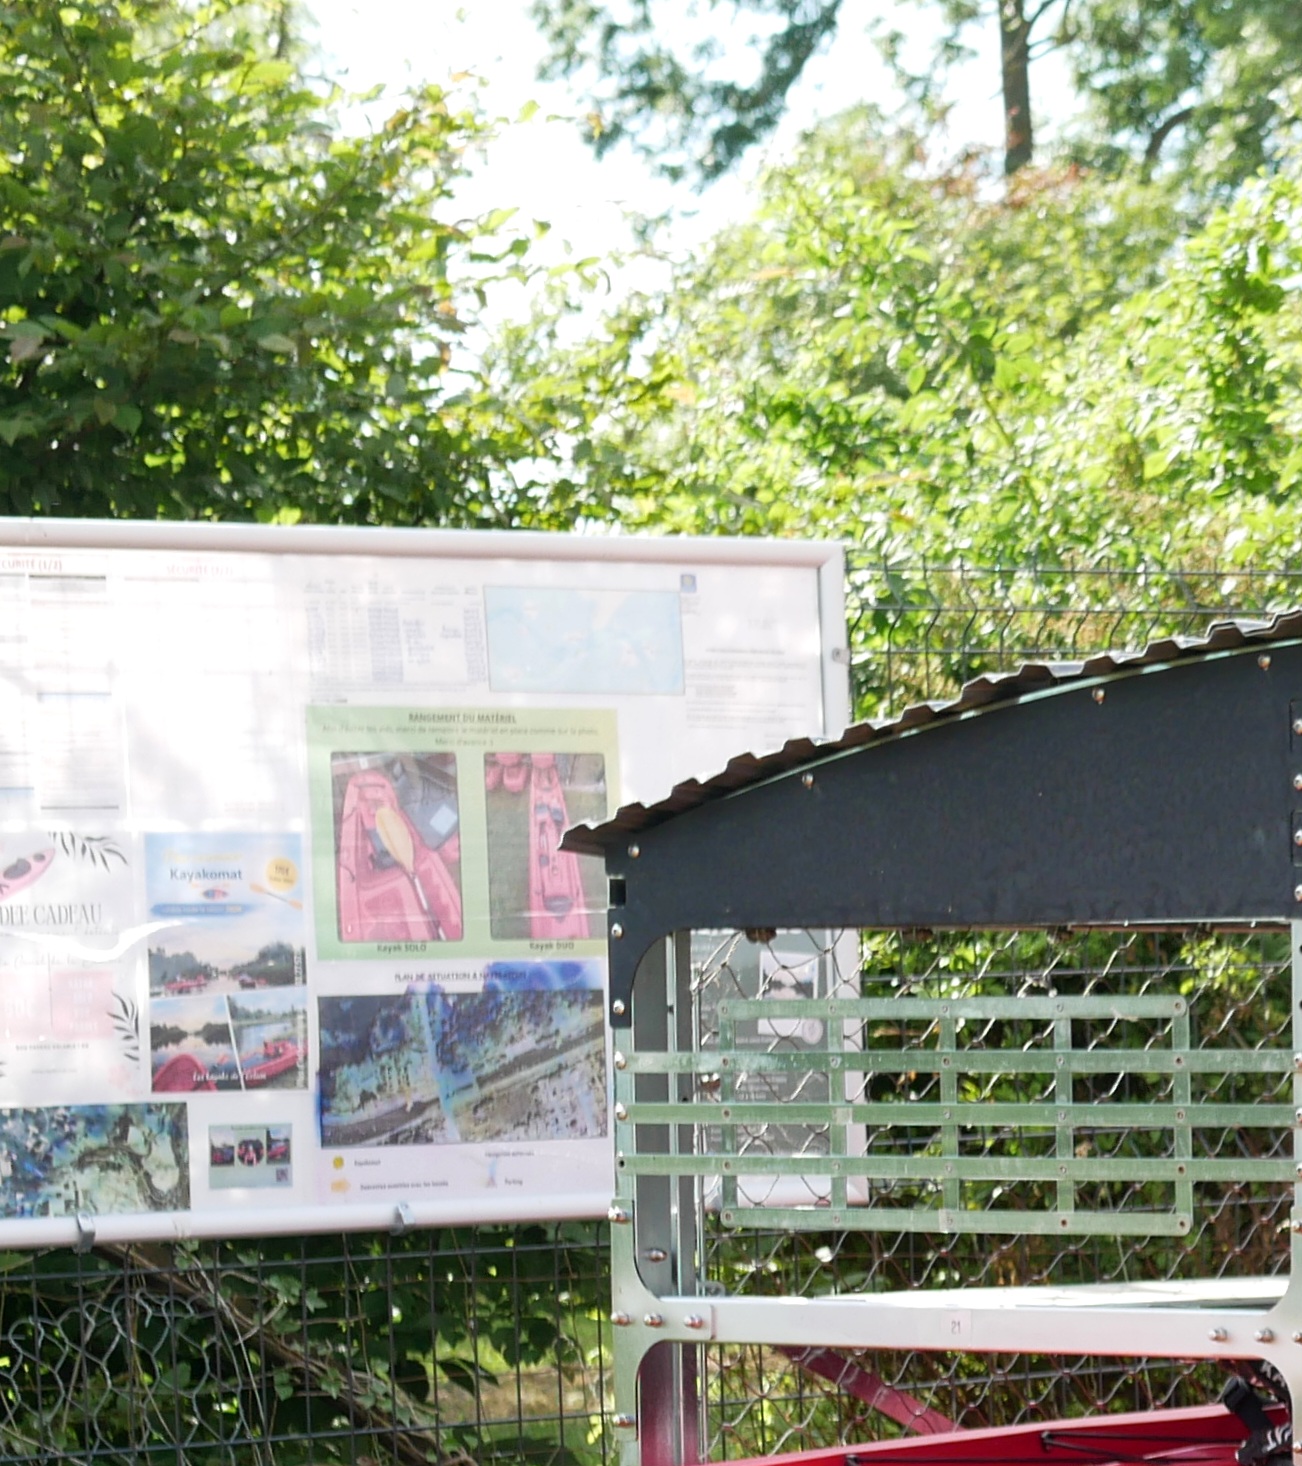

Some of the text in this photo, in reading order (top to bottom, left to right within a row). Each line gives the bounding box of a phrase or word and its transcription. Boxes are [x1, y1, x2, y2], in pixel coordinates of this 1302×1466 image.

[169, 868, 243, 883] Kayakomat
[33, 902, 102, 926] CADEAU
[951, 1320, 961, 1335] 21
